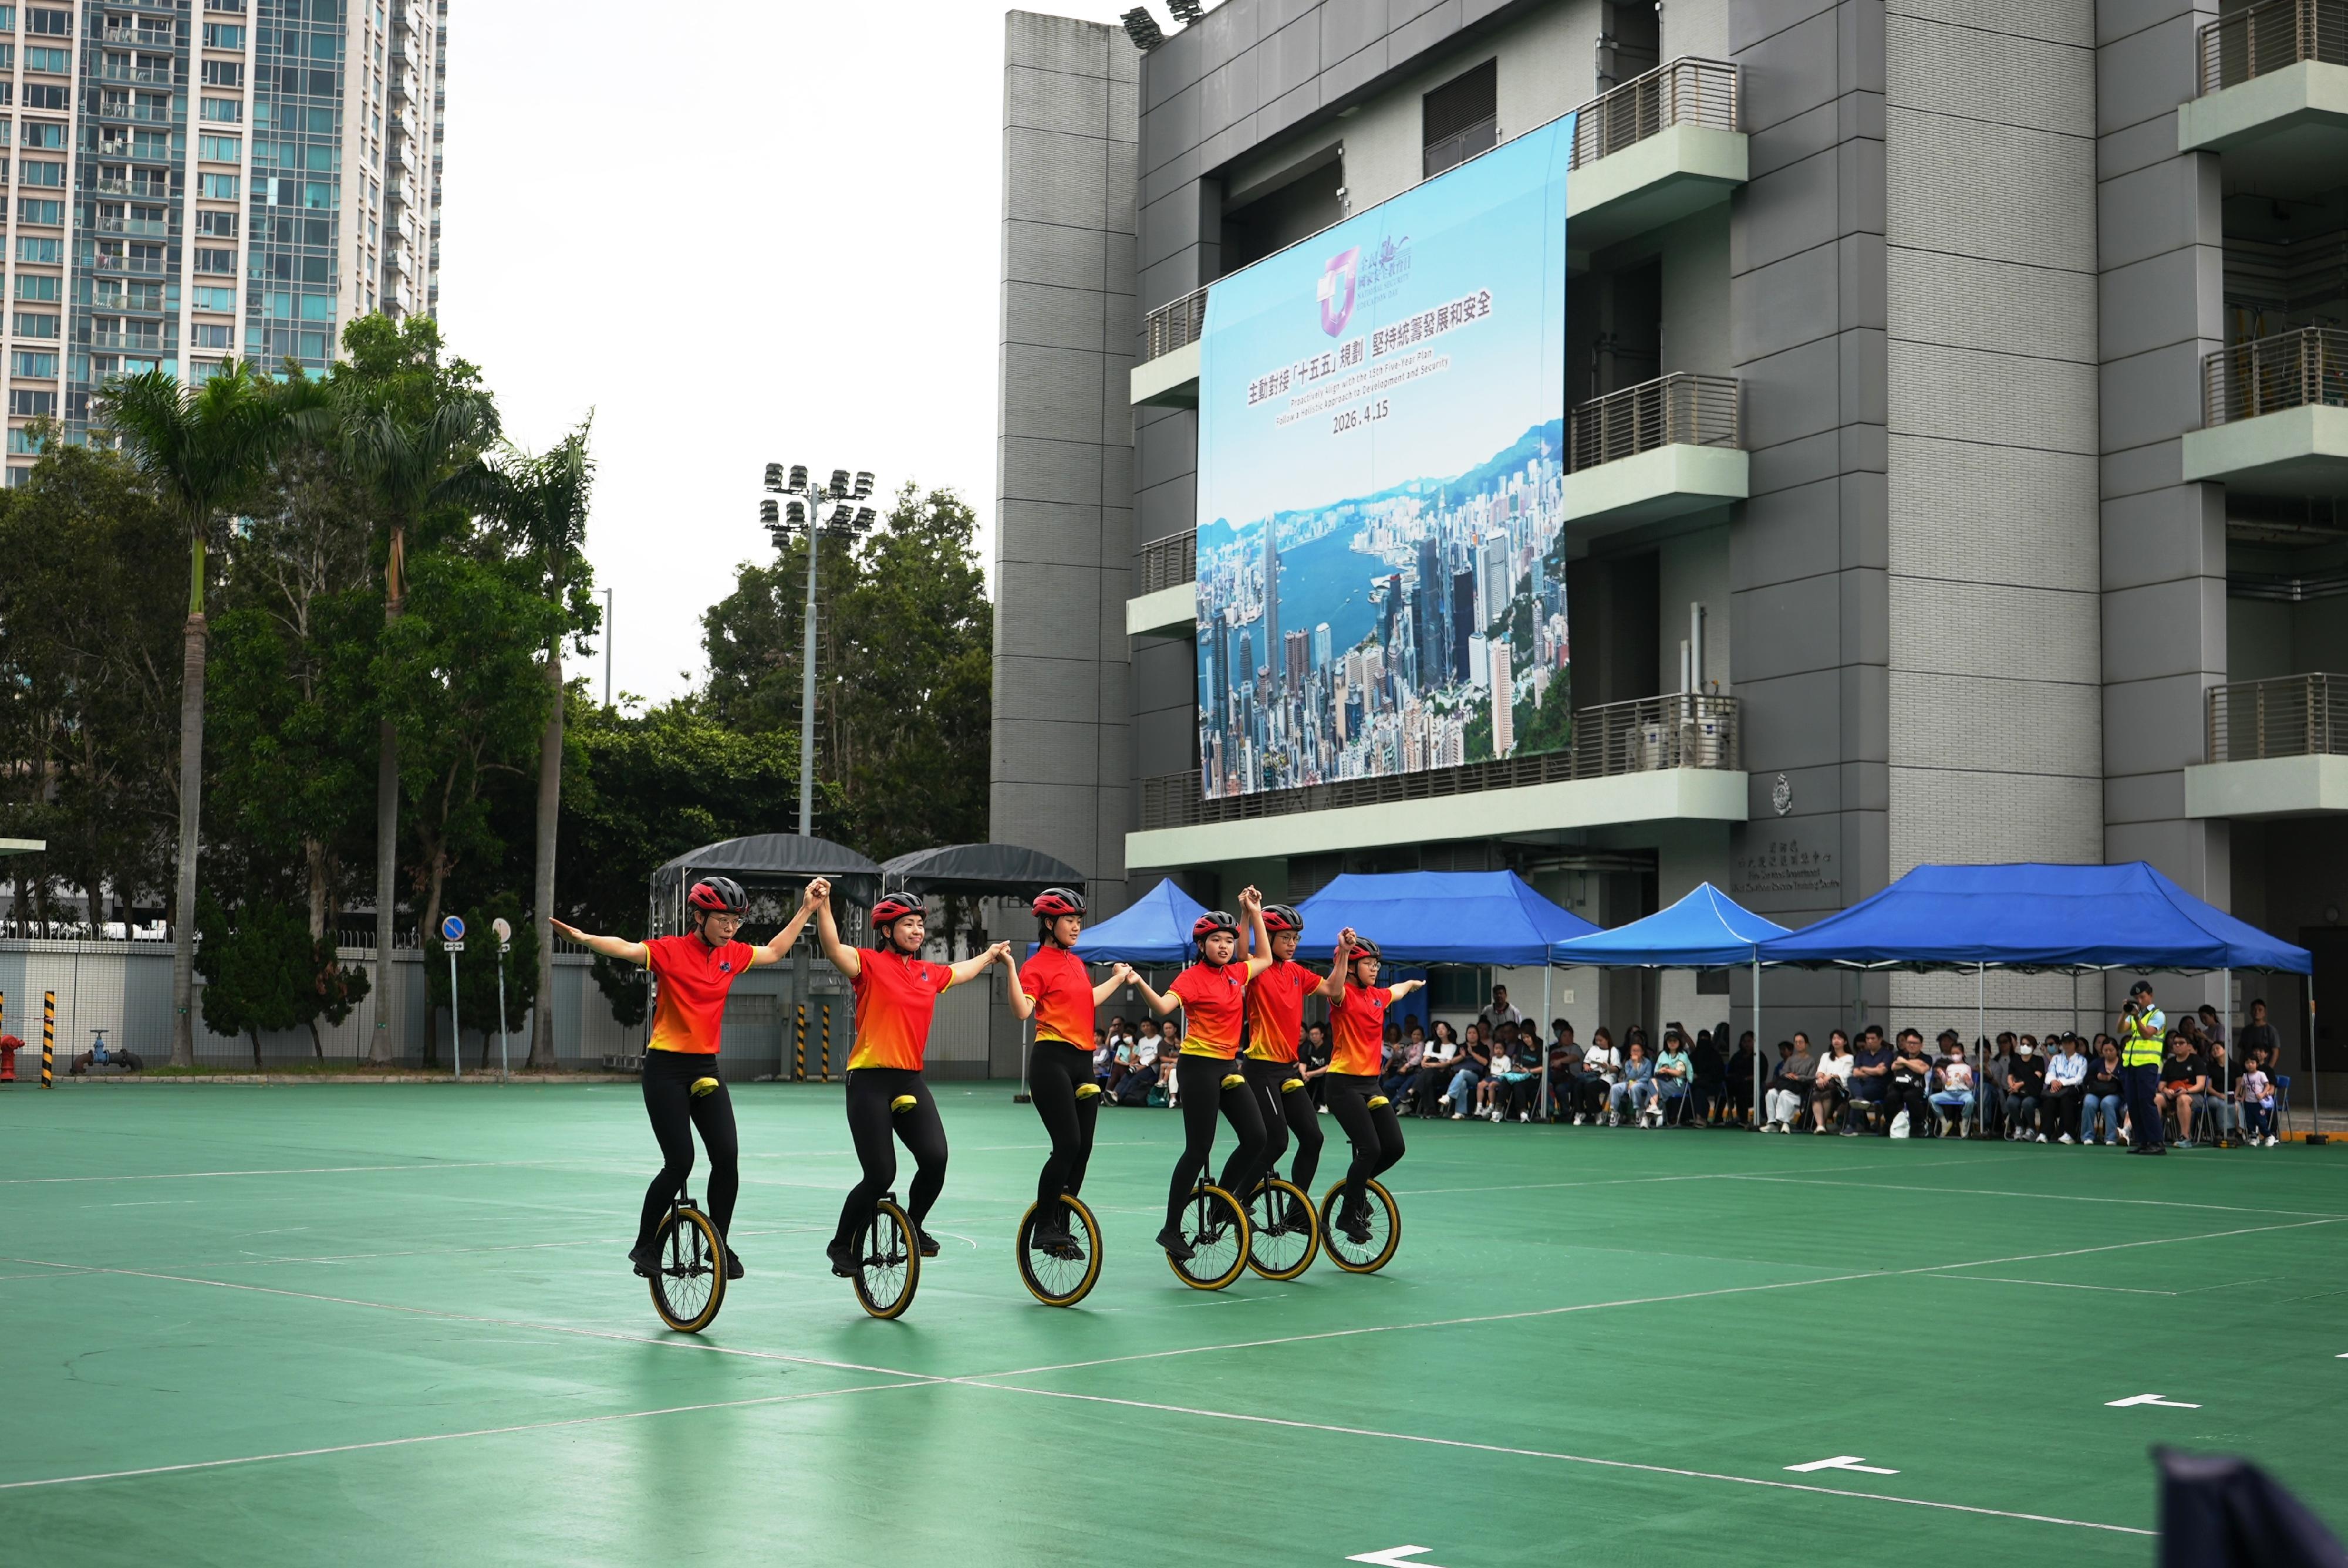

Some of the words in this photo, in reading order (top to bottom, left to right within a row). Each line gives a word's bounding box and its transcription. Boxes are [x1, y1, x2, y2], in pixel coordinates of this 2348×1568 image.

[1248, 338, 1364, 405] 主動對接「十五五」規劃
[1372, 290, 1490, 357] 堅持統籌發展和安全
[1291, 388, 1323, 407] Proactively
[1325, 384, 1340, 394] Align
[1342, 377, 1355, 388] with
[1357, 373, 1367, 383] the
[1369, 367, 1382, 379] 15th
[1385, 356, 1415, 373] Five-Year
[1417, 350, 1432, 361] Plan
[1277, 414, 1294, 425] Follow
[1300, 404, 1323, 417] Holistic
[1325, 391, 1352, 408] Approach
[1362, 372, 1405, 395] Development
[1406, 367, 1419, 379] and
[1421, 357, 1448, 374] Security
[1333, 400, 1388, 434] 2026.4.15
